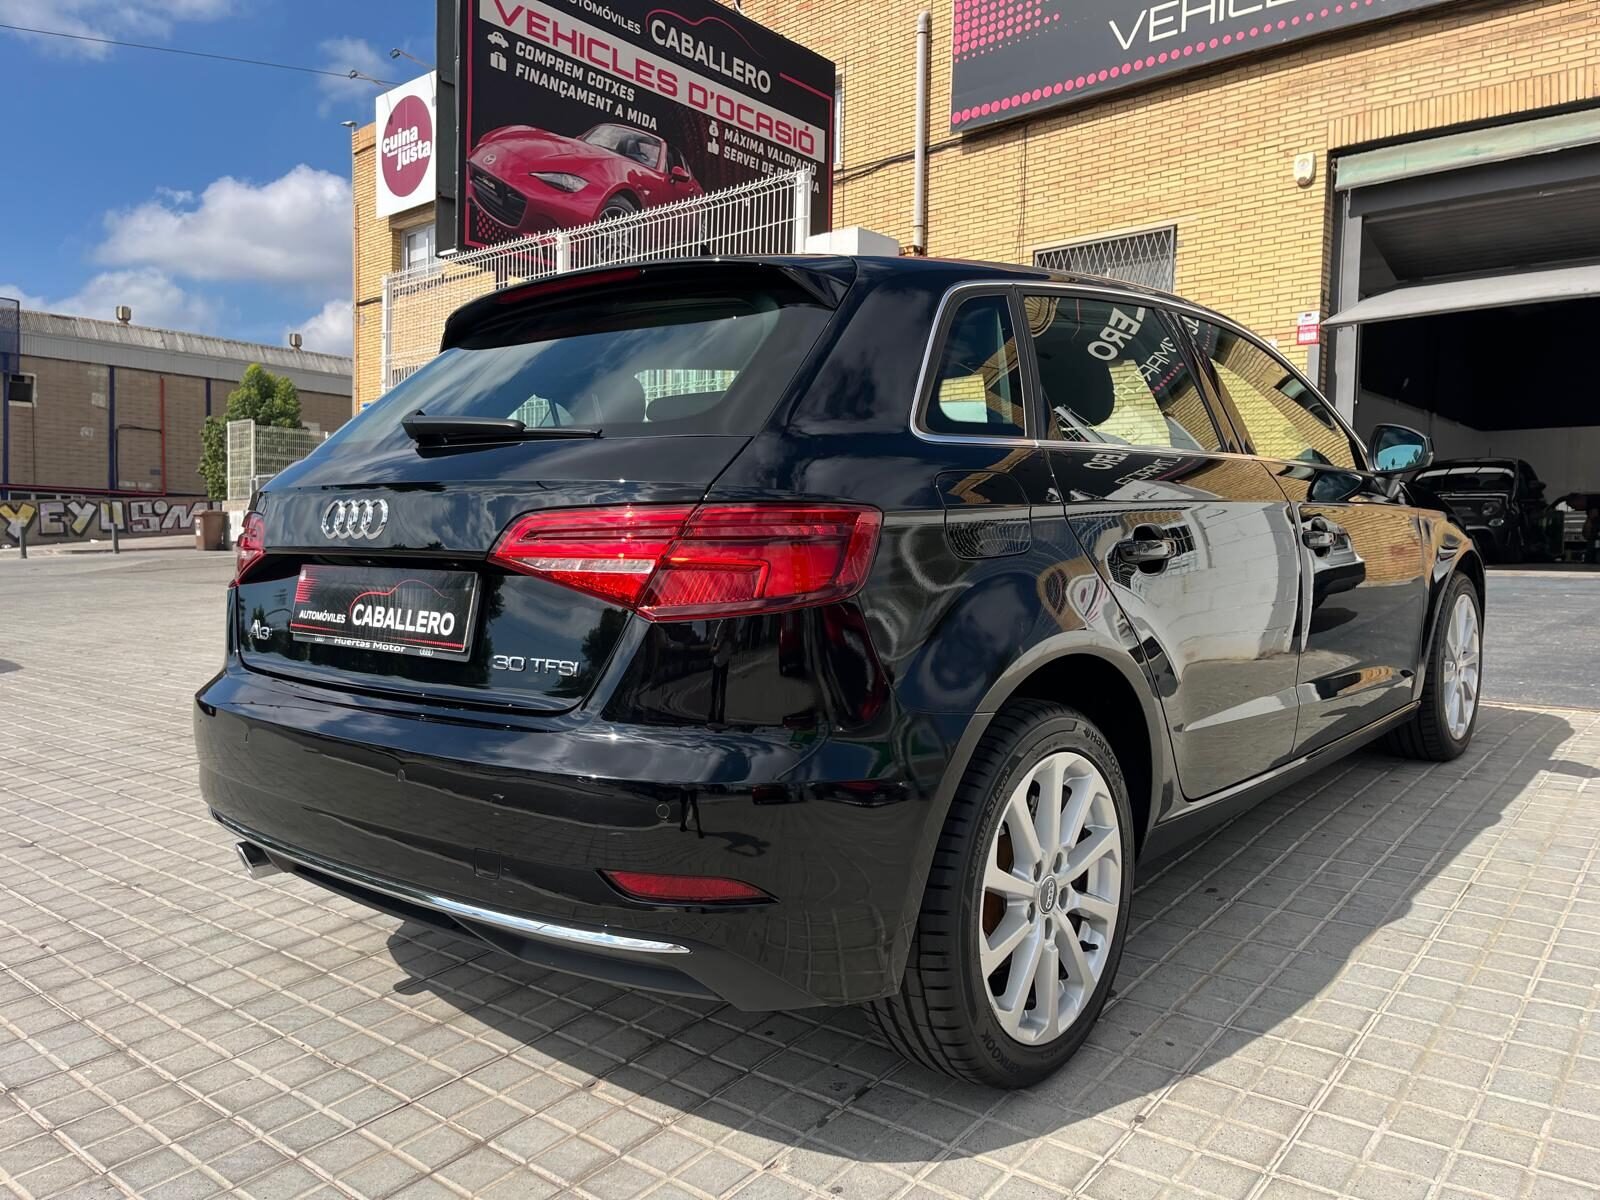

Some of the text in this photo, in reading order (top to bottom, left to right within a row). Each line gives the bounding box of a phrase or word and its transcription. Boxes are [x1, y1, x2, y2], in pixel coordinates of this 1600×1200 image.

[515, 41, 635, 102] COMPREM COTXES
[651, 19, 771, 94] CABALLERO
[494, 0, 815, 155] VEHICLES D'OCASIÓ
[515, 62, 657, 131] FINANÇAMENT A MIDA
[382, 126, 418, 154] cuina
[396, 140, 431, 171] justa
[724, 128, 765, 156] MÀXIMA
[723, 145, 775, 176] SERVEI DE
[248, 619, 270, 640] A3
[298, 603, 455, 636] AUTOMÓVILES CABALLERO
[334, 638, 406, 653] Huertas Motor
[492, 654, 579, 677] 30 TFSI
